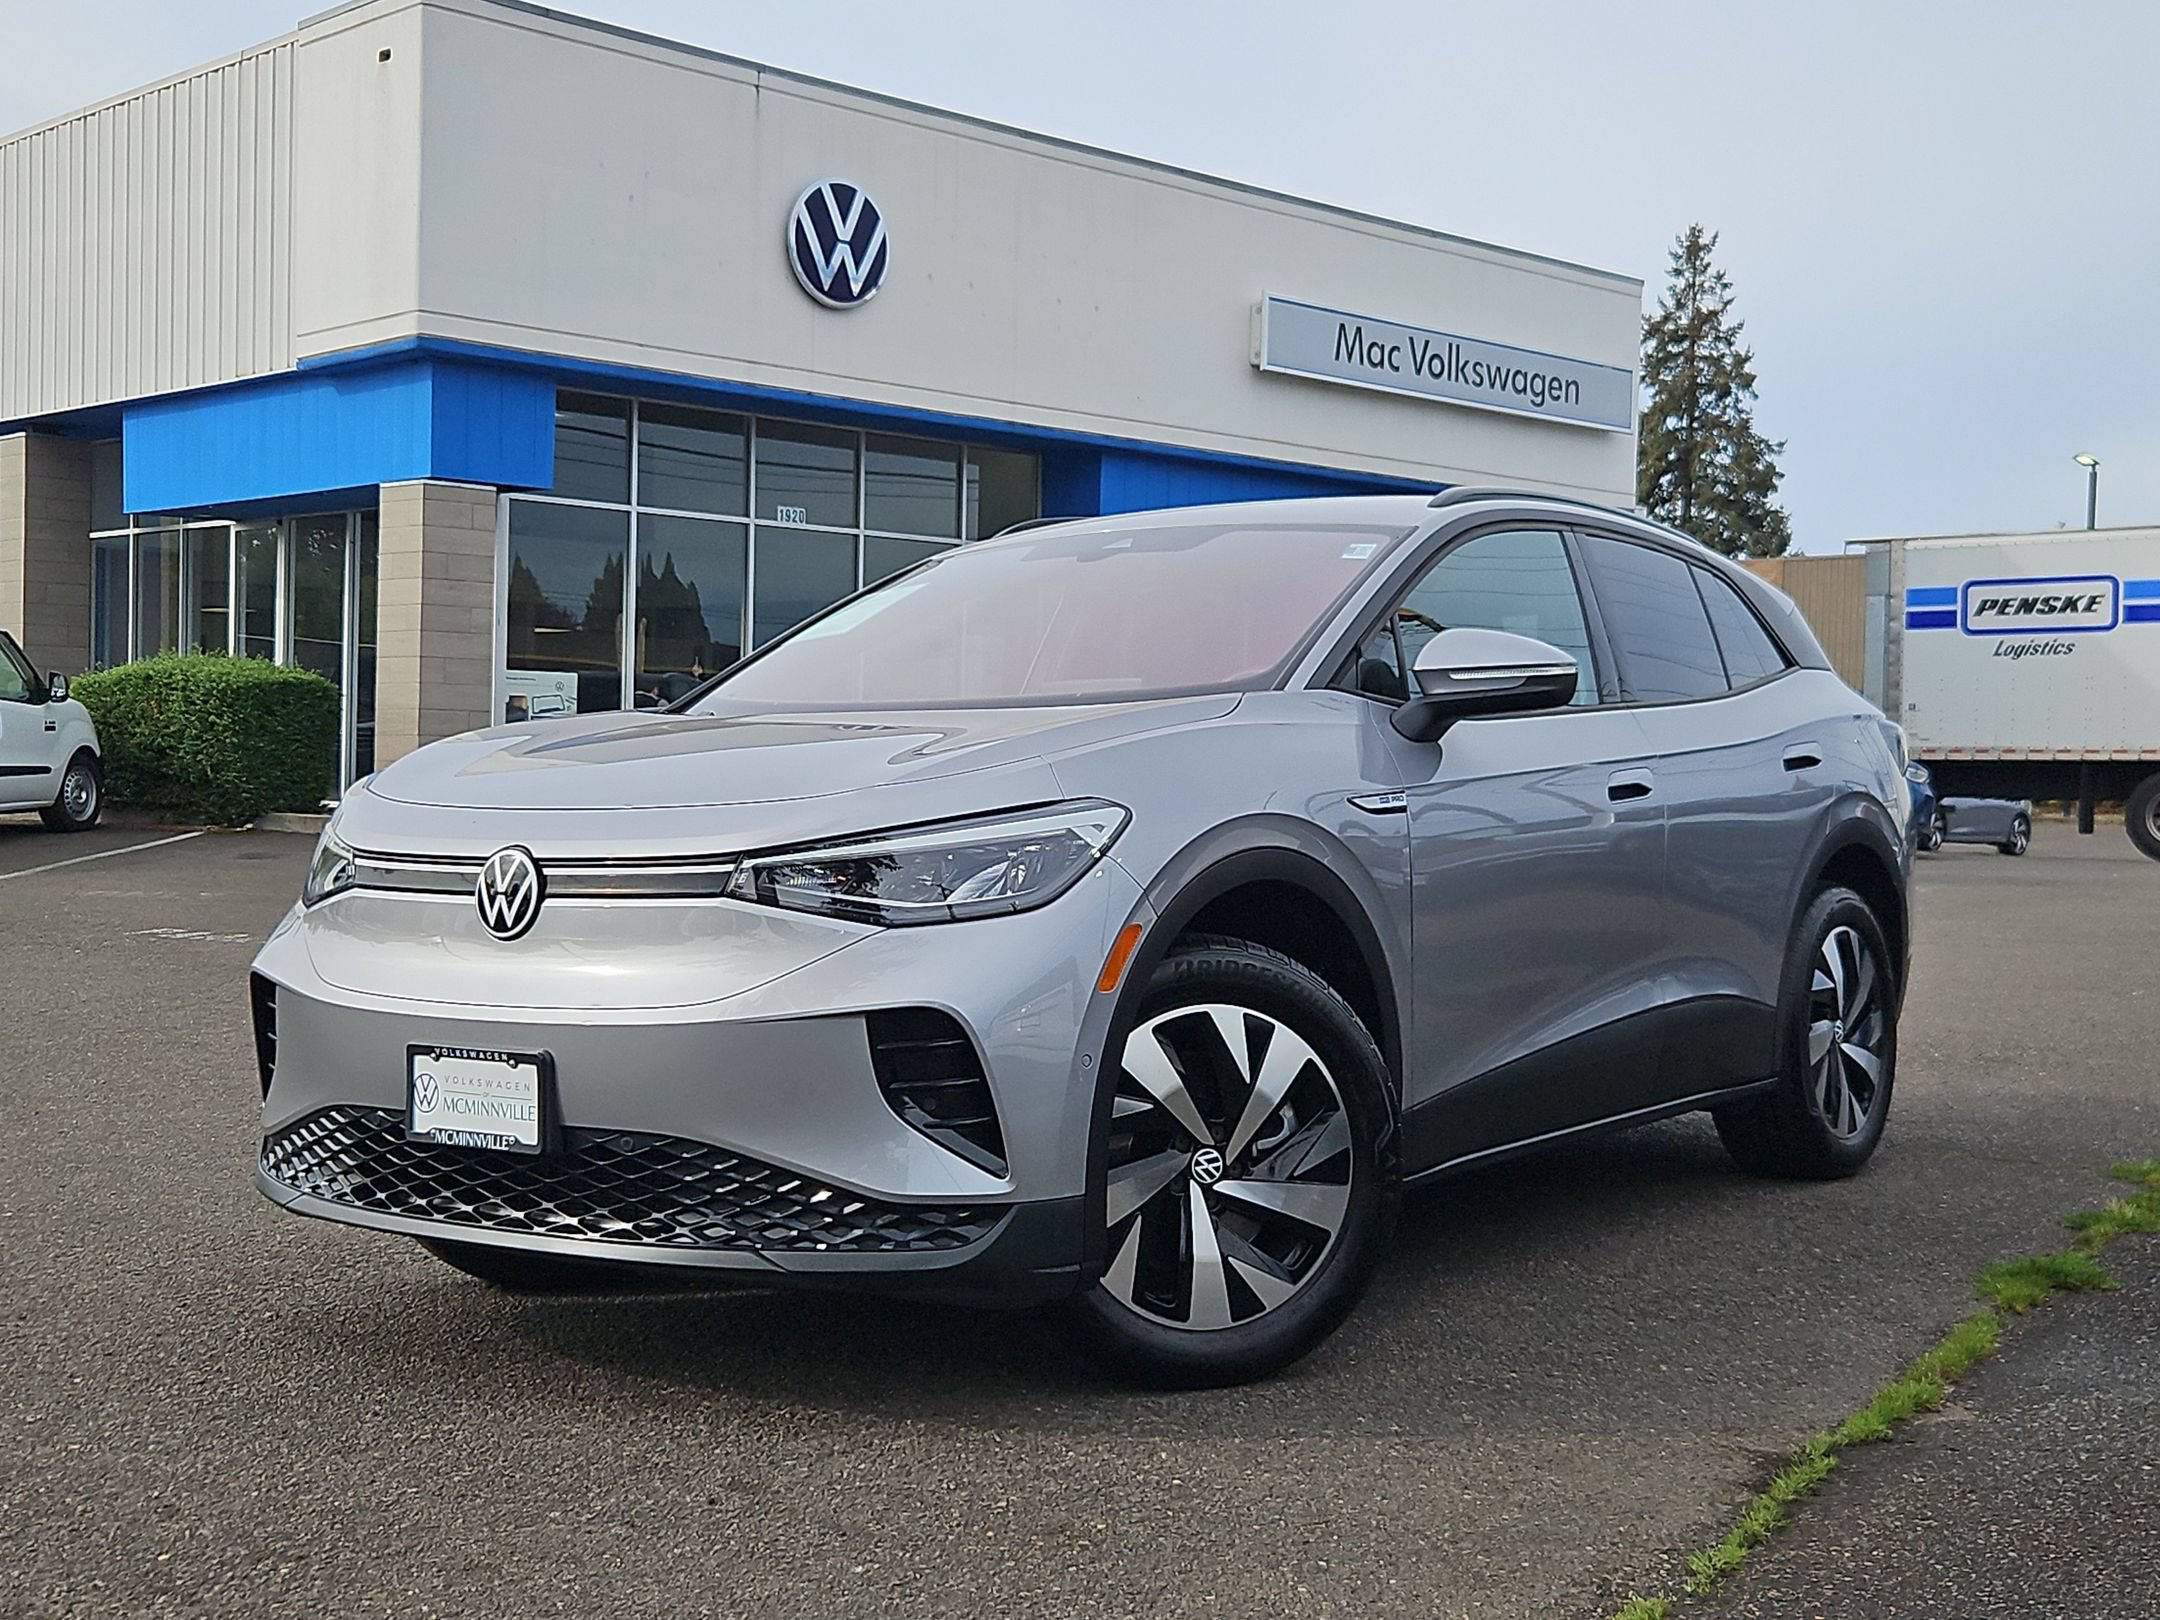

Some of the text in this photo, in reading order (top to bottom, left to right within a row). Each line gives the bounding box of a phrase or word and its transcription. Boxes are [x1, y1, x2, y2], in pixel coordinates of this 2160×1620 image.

[1333, 322, 1580, 408] Mac Volkswagen
[779, 508, 805, 524] 1920
[1972, 593, 2106, 617] PENSKE
[1992, 638, 2077, 661] Logistics
[434, 1047, 509, 1061] VOLKSWAGEN
[444, 1075, 531, 1092] VOLKSWAGEN
[443, 1097, 536, 1122] MCMINNVILLE
[434, 1130, 510, 1151] MCMINNVILLE
